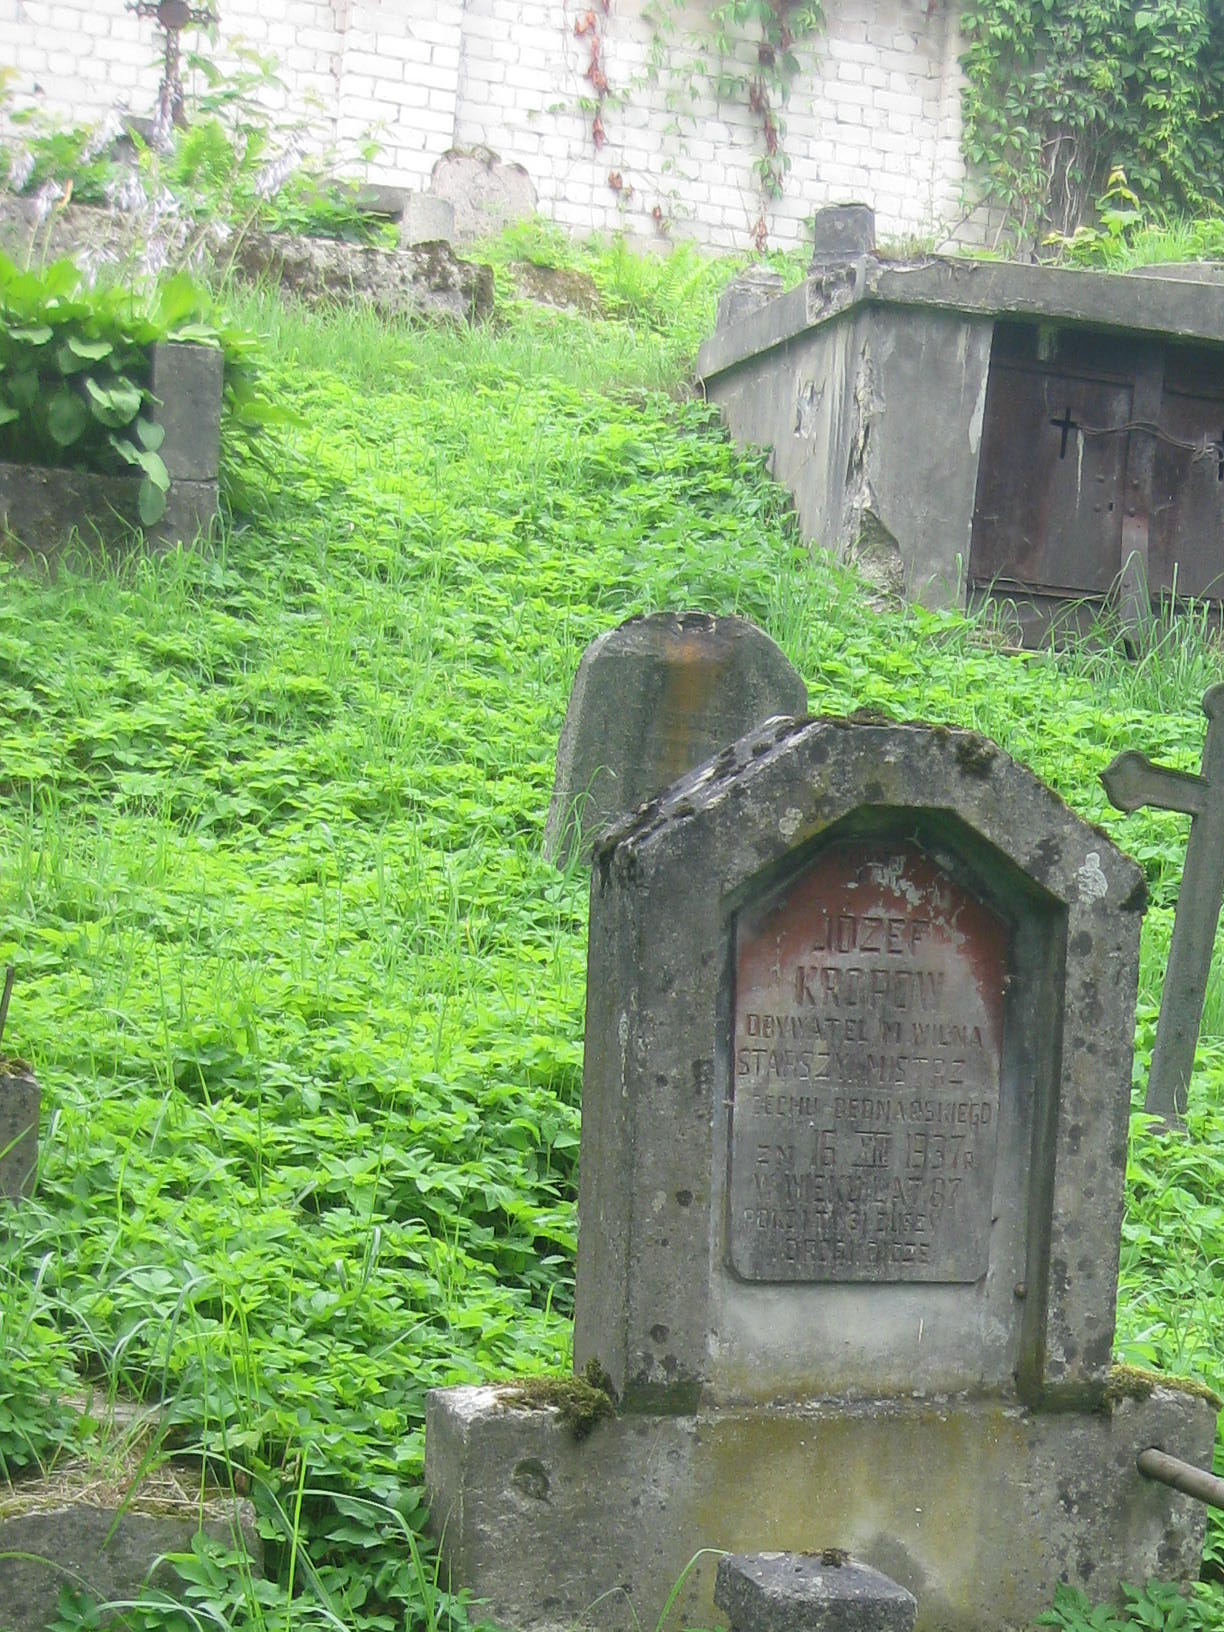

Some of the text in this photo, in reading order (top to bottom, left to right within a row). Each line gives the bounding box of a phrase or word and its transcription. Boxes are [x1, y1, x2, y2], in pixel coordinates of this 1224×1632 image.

[745, 1013, 869, 1046] OBYWATEL
[737, 1048, 966, 1086] STARSZY MISTRZ
[834, 1097, 993, 1126] BEDNARSKIEGO
